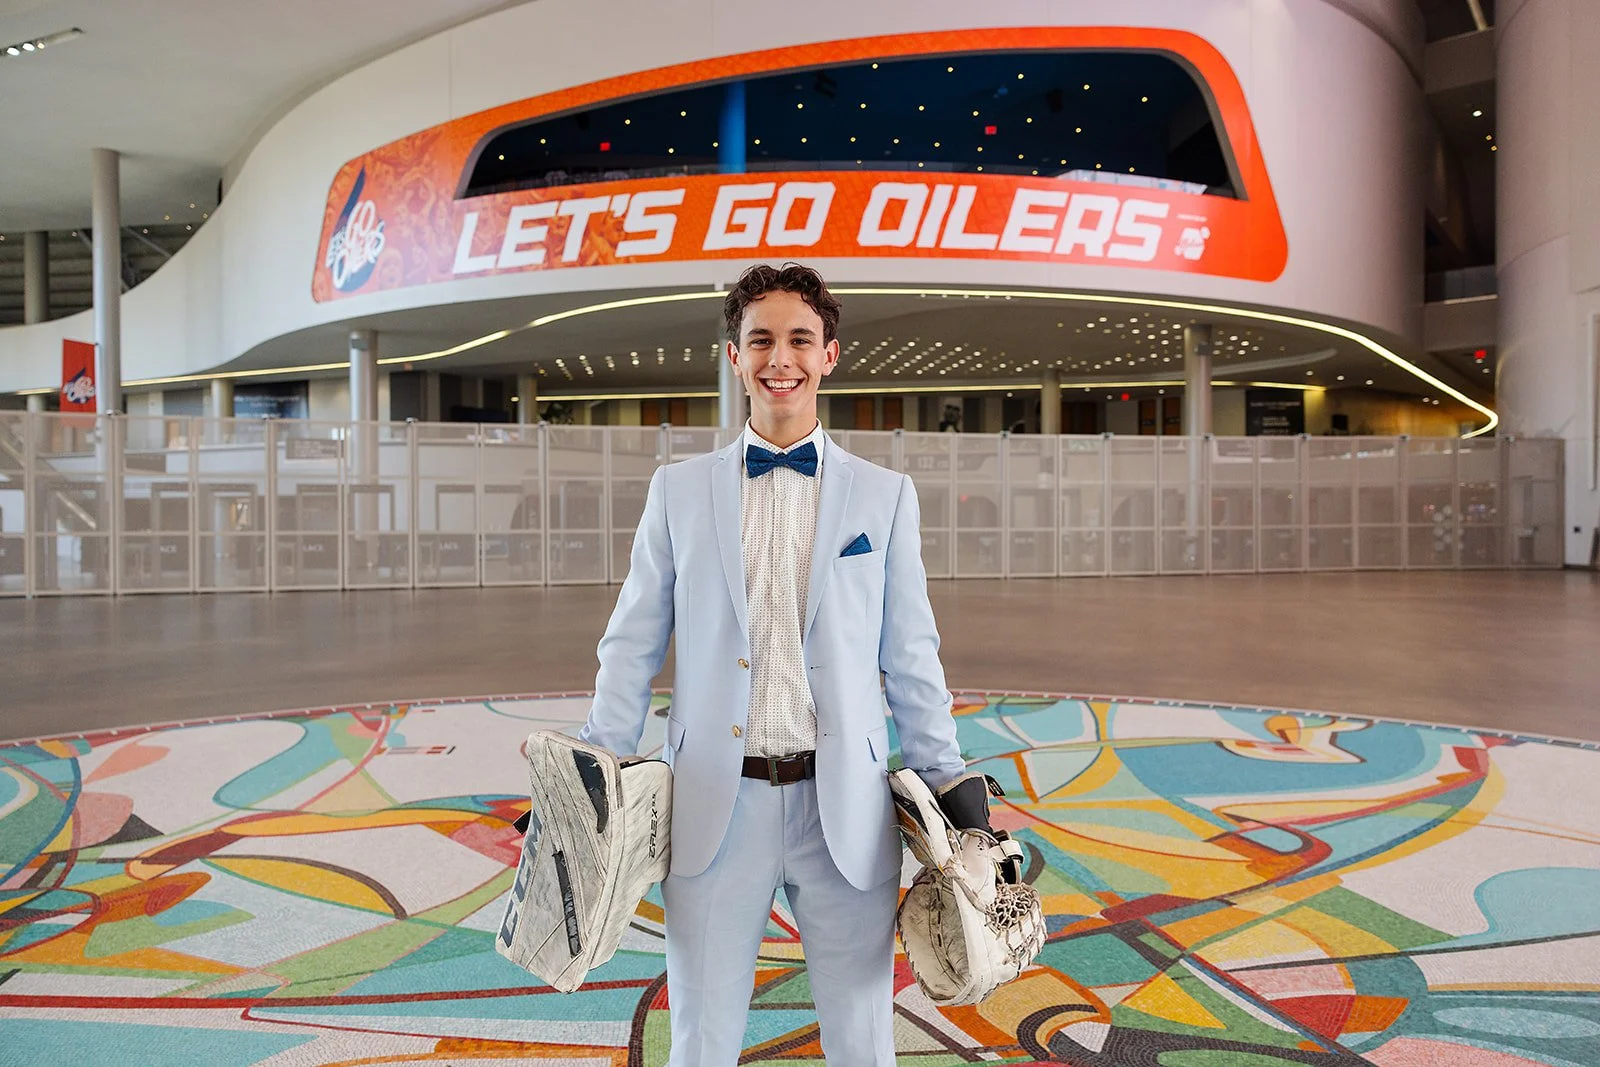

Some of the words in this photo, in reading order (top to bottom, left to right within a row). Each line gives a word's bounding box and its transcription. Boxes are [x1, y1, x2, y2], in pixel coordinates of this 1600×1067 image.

[451, 187, 686, 274] LET'S
[702, 181, 837, 252] GO
[856, 181, 1170, 262] OILERS
[499, 811, 543, 948] CCM
